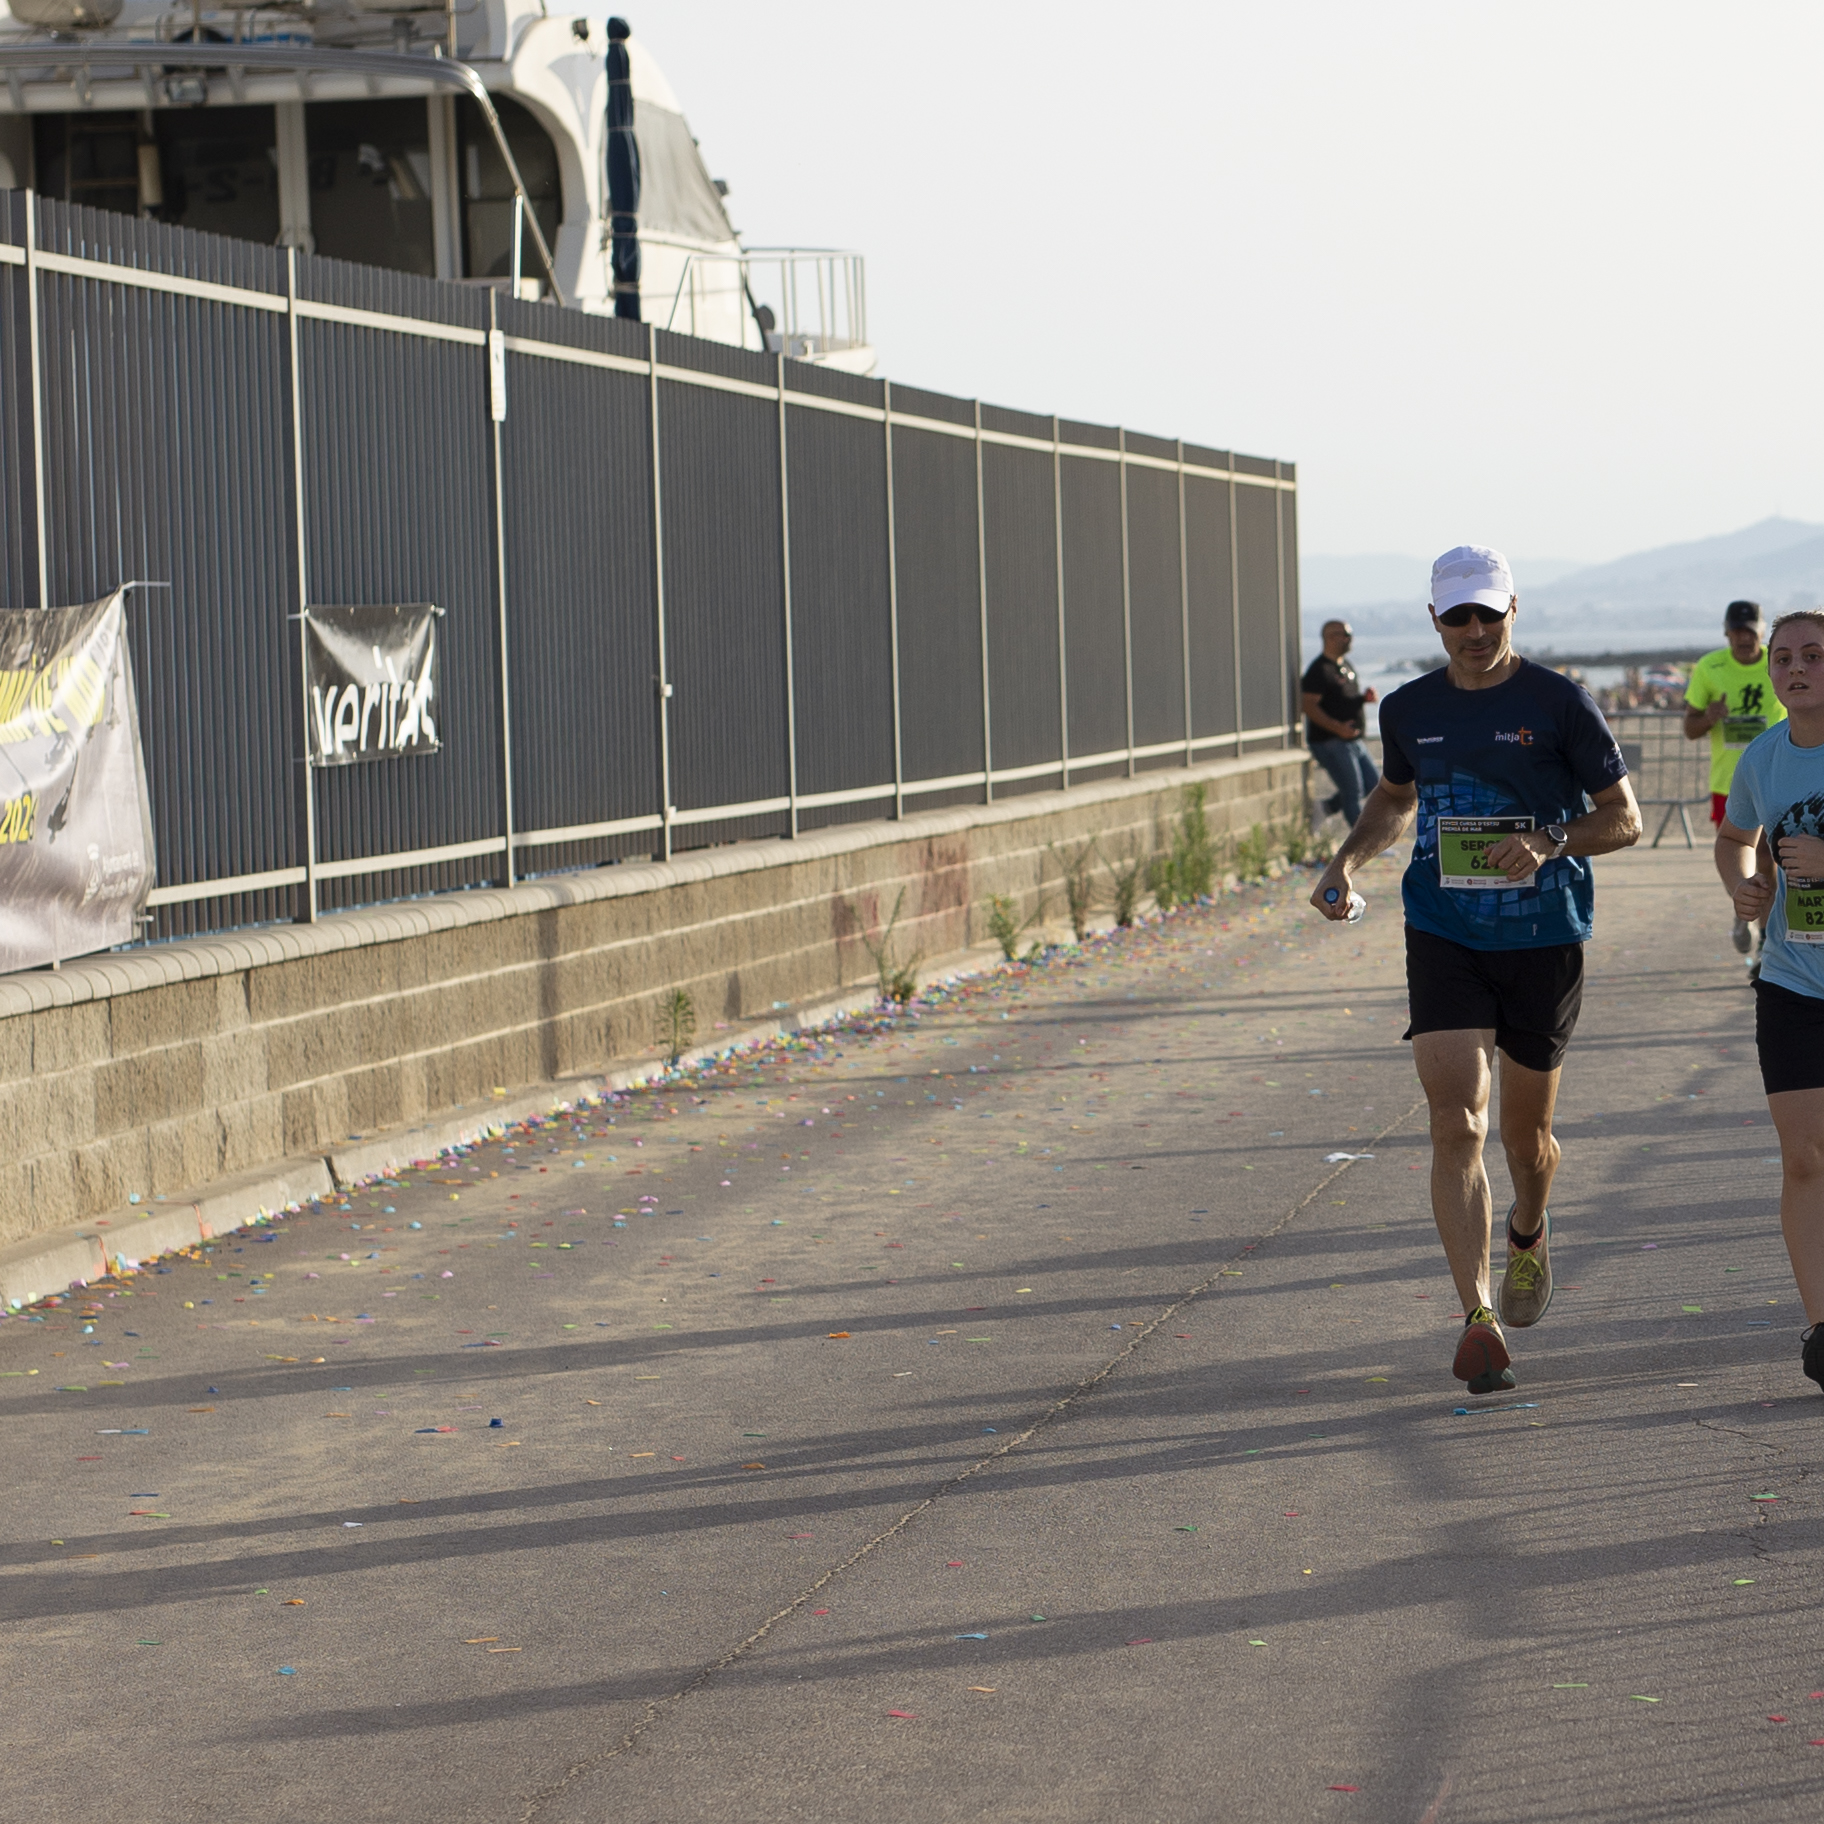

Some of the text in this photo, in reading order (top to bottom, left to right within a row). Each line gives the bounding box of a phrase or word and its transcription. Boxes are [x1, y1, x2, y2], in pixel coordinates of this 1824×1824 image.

[0, 790, 38, 844] 202
[1514, 821, 1527, 830] 5K
[1460, 839, 1500, 851] SER
[1470, 855, 1500, 870] 62
